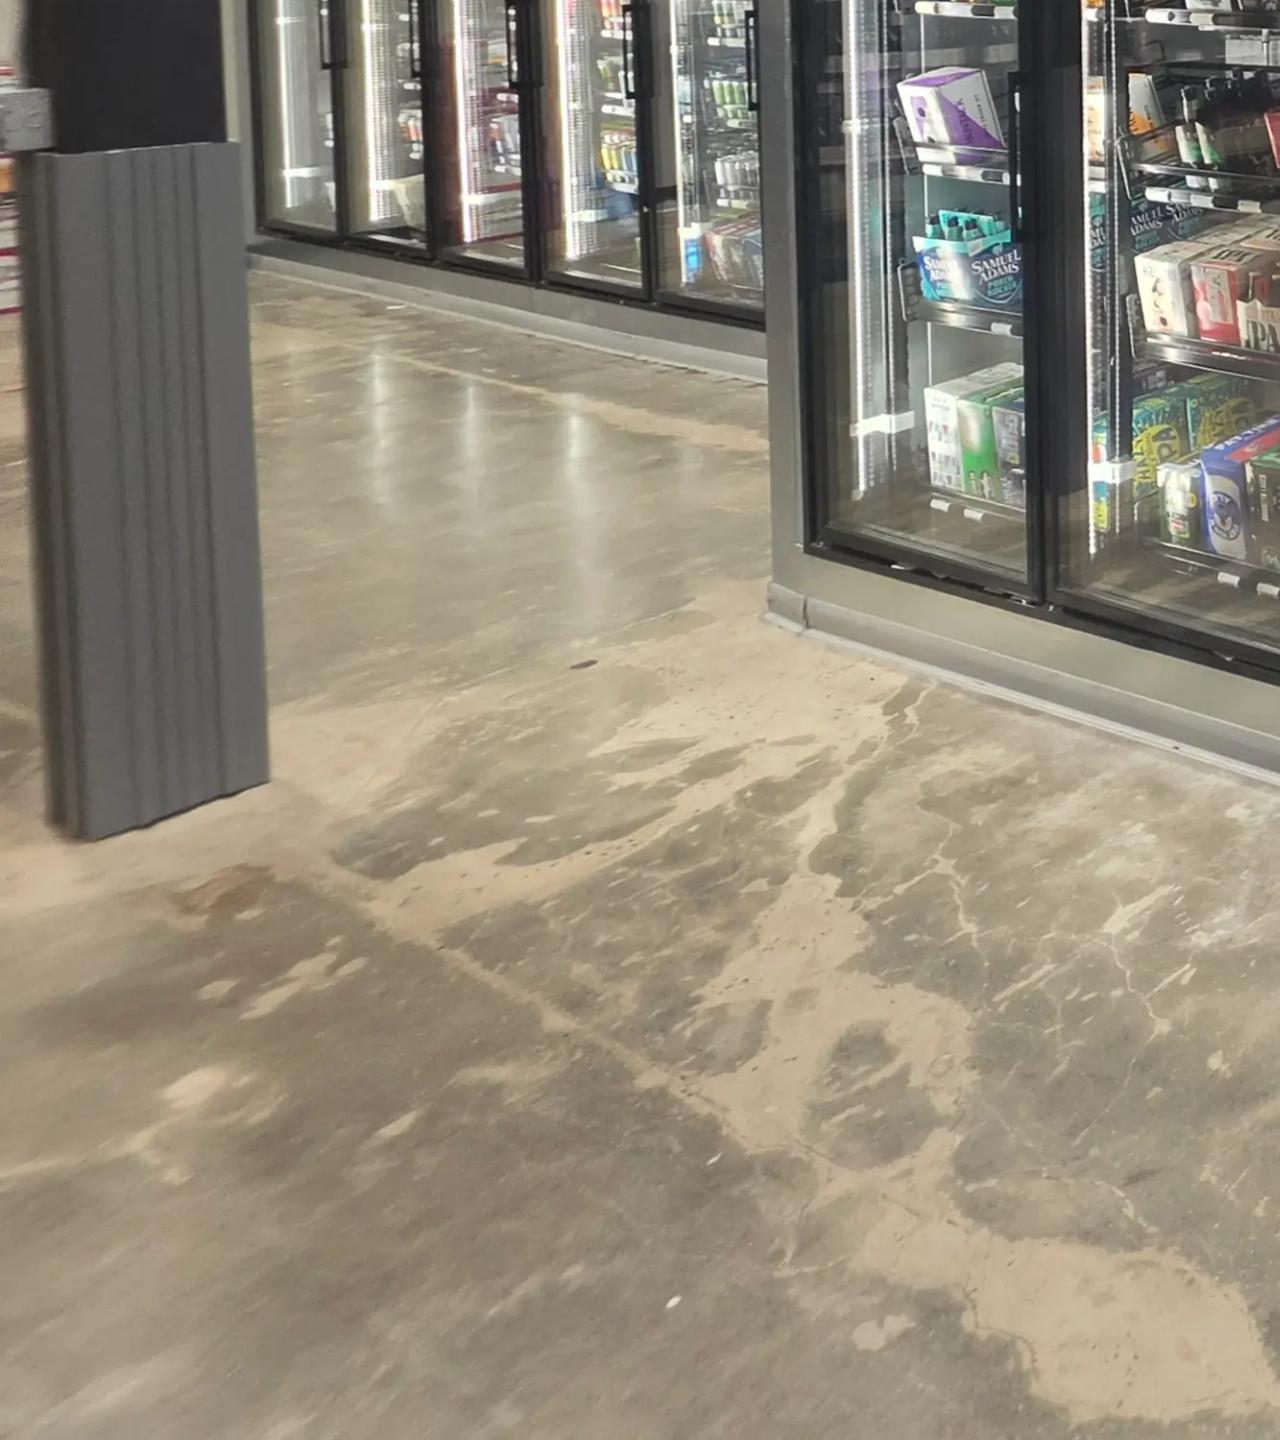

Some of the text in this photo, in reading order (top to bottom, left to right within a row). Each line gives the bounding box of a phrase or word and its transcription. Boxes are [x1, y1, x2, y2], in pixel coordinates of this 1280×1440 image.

[1130, 208, 1164, 226] AMUEL
[971, 249, 1022, 276] SAMUEL
[980, 262, 1020, 282] ADAMS
